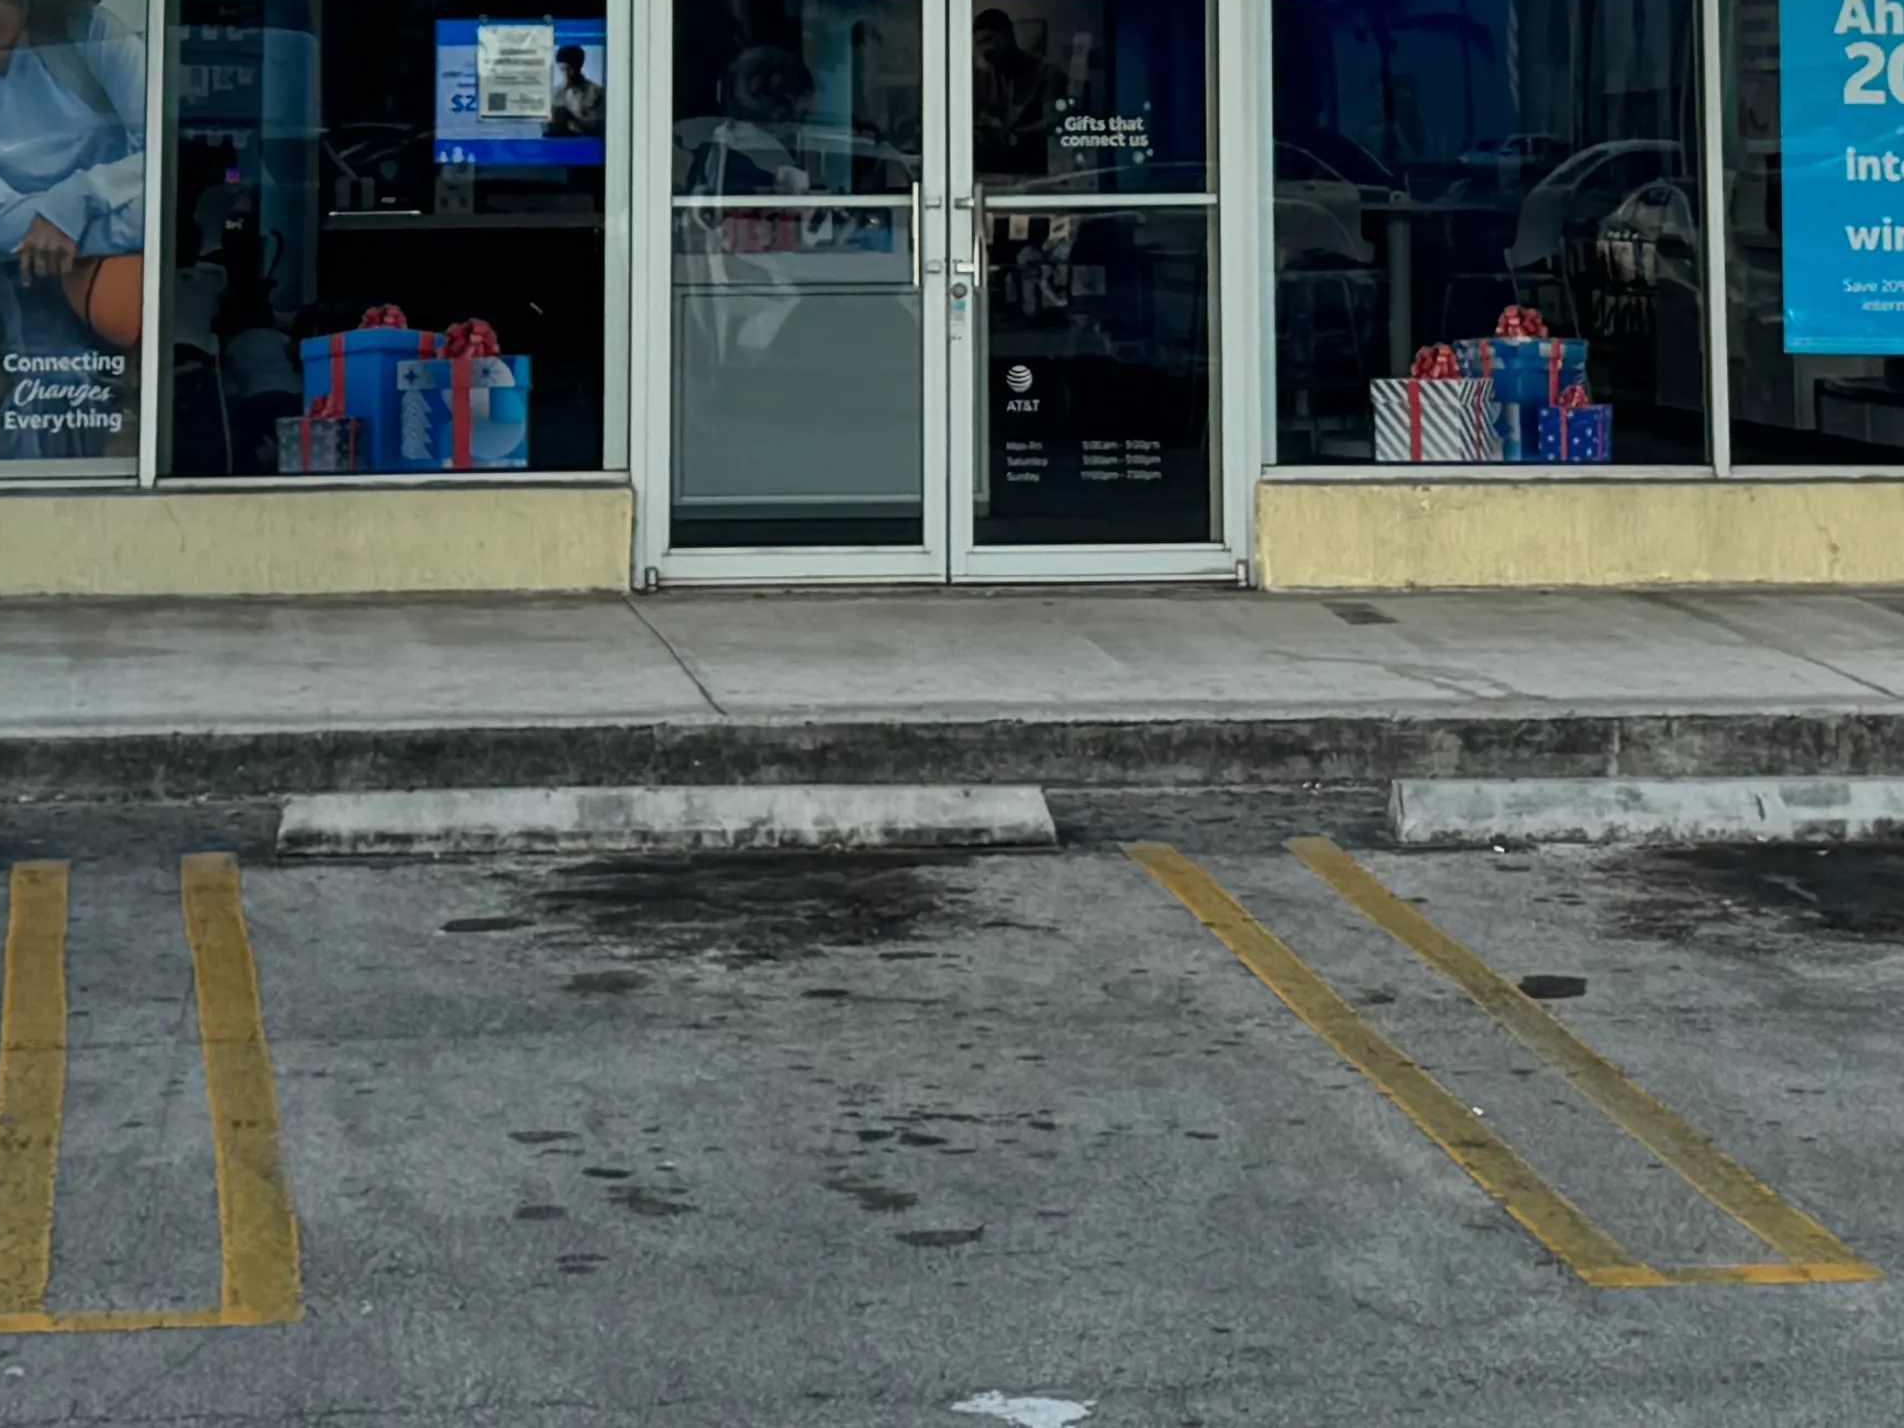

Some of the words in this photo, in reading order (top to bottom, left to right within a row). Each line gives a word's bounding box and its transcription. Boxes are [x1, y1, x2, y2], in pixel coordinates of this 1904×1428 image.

[1064, 116, 1105, 131] Gifts
[1108, 115, 1144, 131] that
[1060, 133, 1126, 147] connect
[1129, 134, 1149, 147] us
[1843, 279, 1877, 293] Save
[3, 350, 125, 375] Connecting
[13, 378, 114, 407] Changes
[1006, 399, 1040, 412] AT&T
[3, 409, 123, 433] Everything
